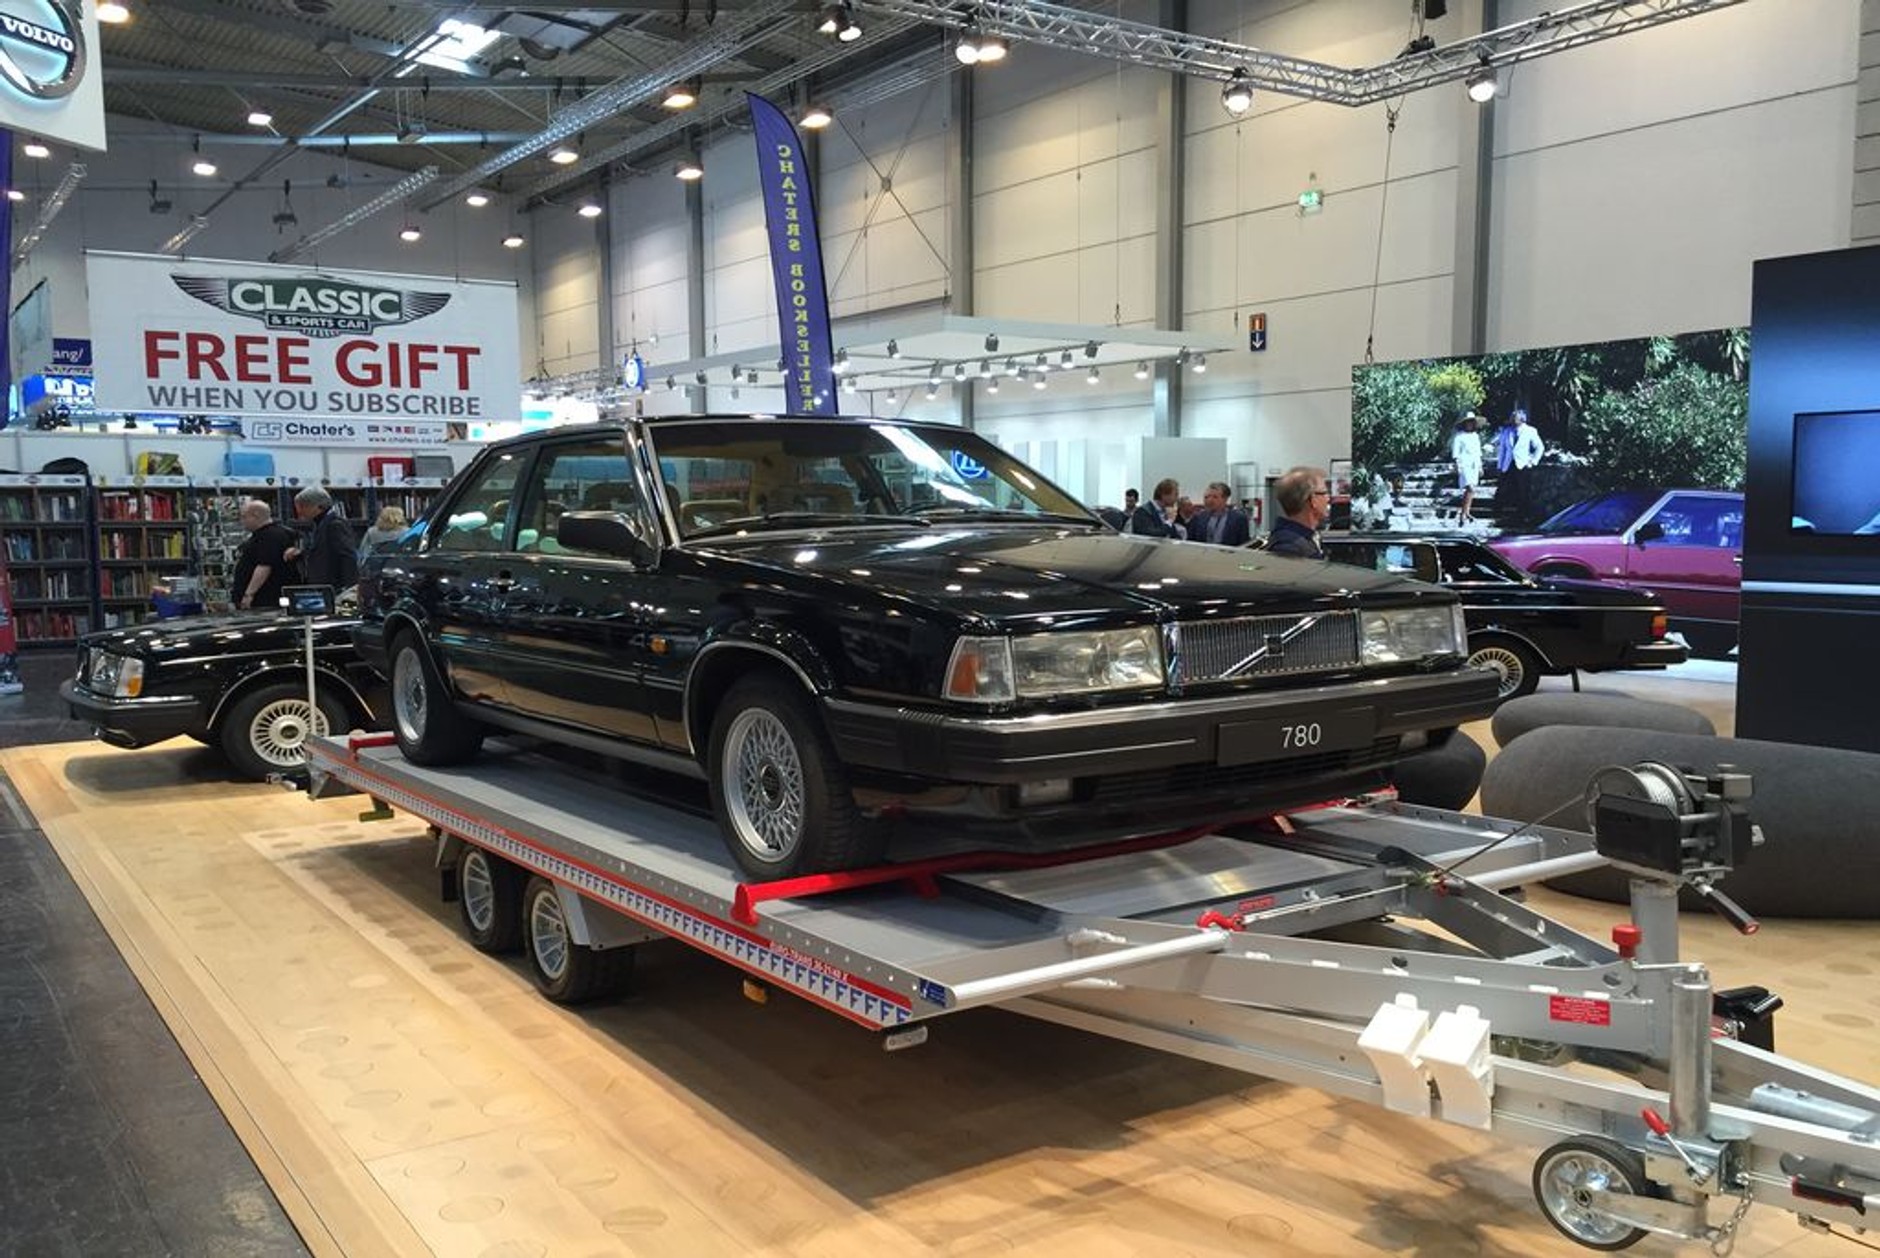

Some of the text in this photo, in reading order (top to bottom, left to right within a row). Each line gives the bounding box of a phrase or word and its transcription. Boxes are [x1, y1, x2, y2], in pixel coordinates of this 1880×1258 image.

[0, 16, 75, 52] VOLVO
[231, 282, 400, 321] CLASSIC
[271, 316, 366, 329] & SPORTS CAR
[145, 331, 481, 391] FREE GIFT
[147, 386, 481, 416] WHEN YOU SUBSCRIBE
[286, 422, 355, 436] Chater's
[1281, 723, 1321, 748] 780
